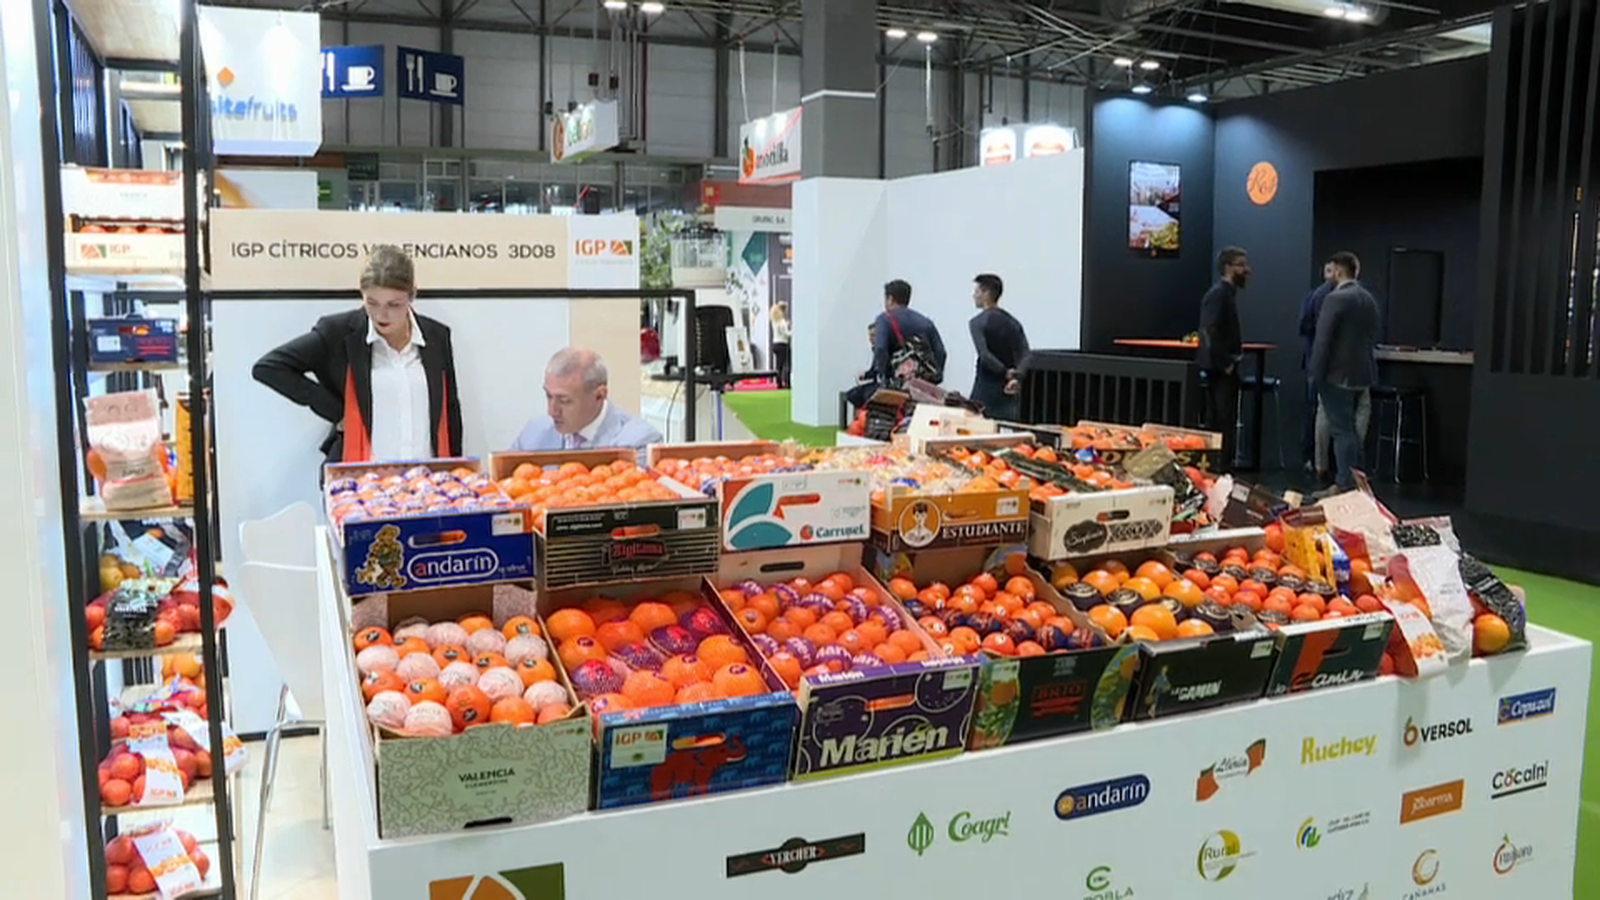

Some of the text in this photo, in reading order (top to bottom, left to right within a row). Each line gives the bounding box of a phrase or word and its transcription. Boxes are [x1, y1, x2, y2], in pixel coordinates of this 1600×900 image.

[231, 242, 264, 258] IGP
[268, 239, 359, 259] CÍTRICOS
[508, 243, 556, 259] 3D08
[575, 239, 606, 256] IGP
[942, 522, 1026, 539] ESTUDIANTE
[413, 553, 493, 577] andarín
[615, 731, 643, 746] IGP
[818, 723, 950, 768] Marién
[1300, 734, 1377, 765] Ruchey
[458, 767, 516, 784] VALENCIA
[1076, 781, 1147, 811] andarín
[948, 810, 1012, 844] Coagri
[769, 845, 818, 866] VERCHER
